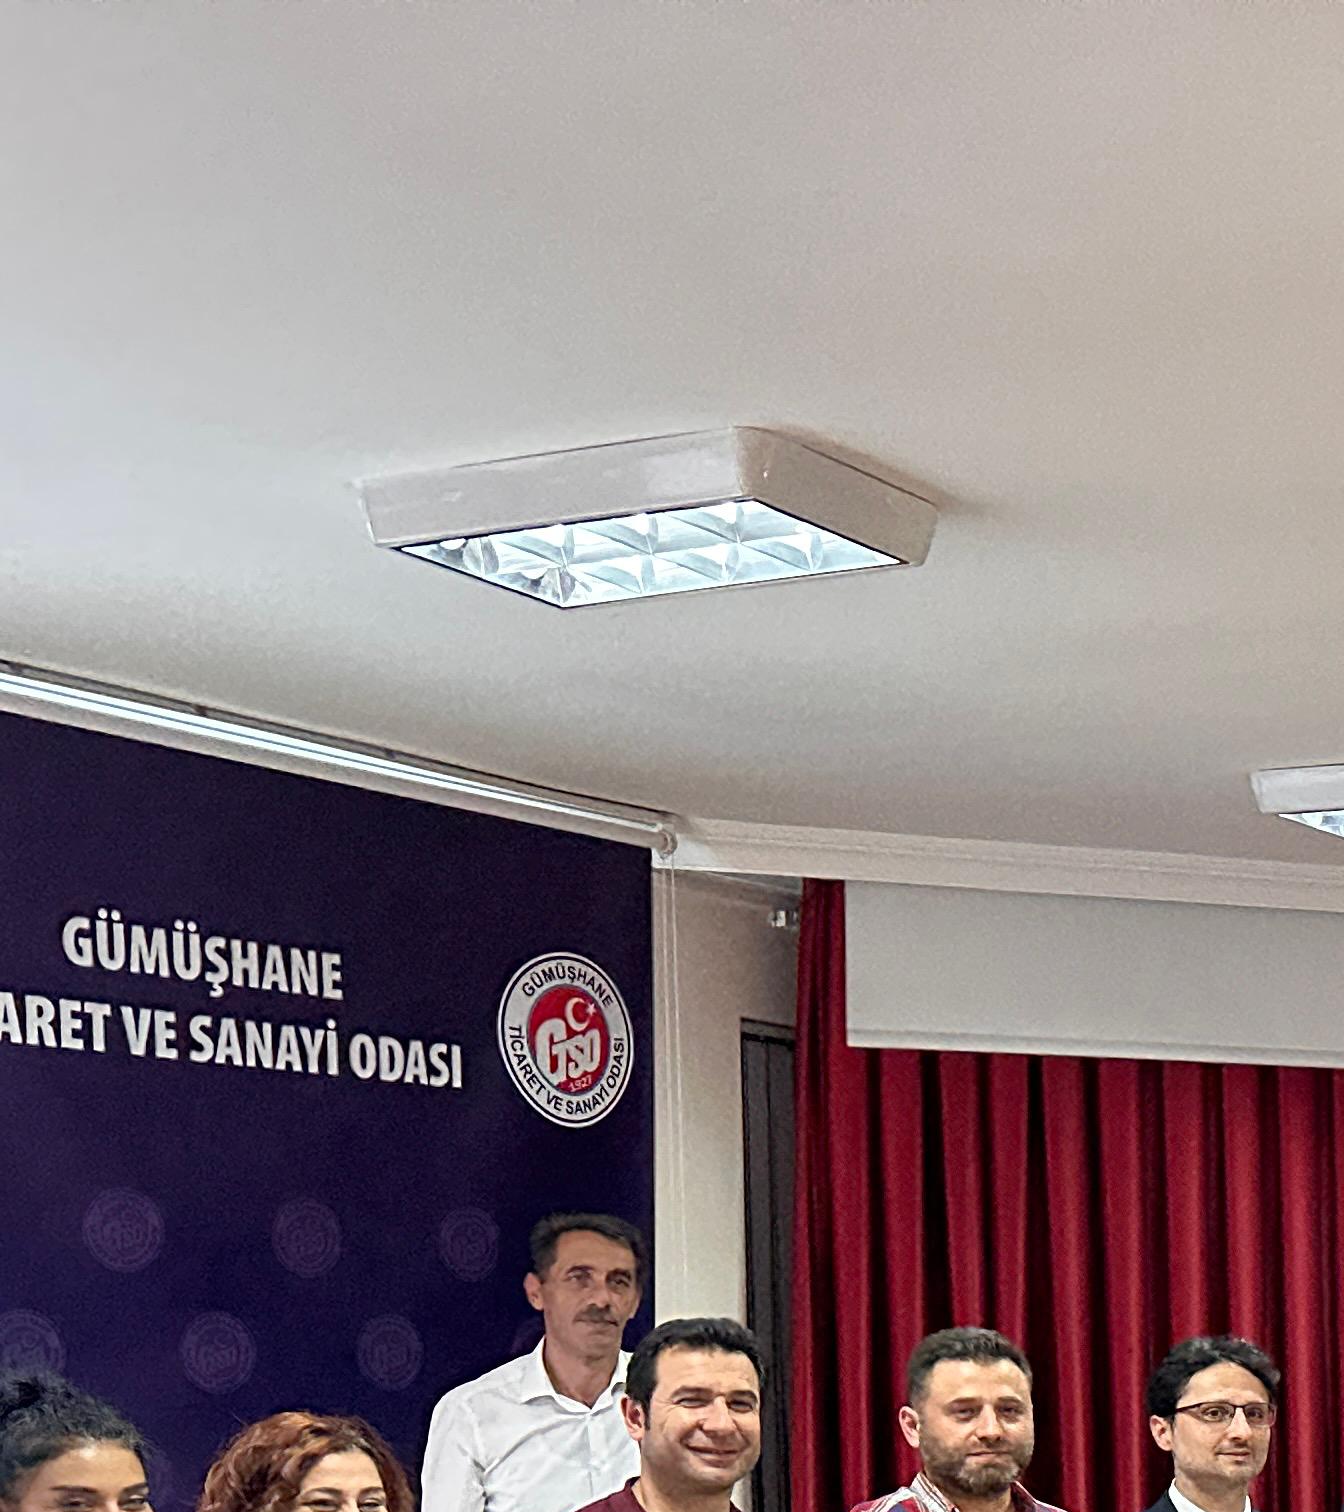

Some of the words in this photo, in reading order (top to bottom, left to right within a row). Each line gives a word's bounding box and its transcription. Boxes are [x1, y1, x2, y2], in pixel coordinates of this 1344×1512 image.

[62, 908, 343, 1000] GÜMÜŞHANE
[522, 963, 613, 1007] GÜMÜŞHANE
[119, 1005, 178, 1060] VE
[189, 1014, 339, 1076] SANAYİ
[349, 1033, 462, 1088] ODASI
[509, 1024, 546, 1094] TİCARET
[546, 1092, 563, 1111] VE
[566, 1088, 610, 1115] SANAYİ
[606, 1037, 625, 1089] ODASI
